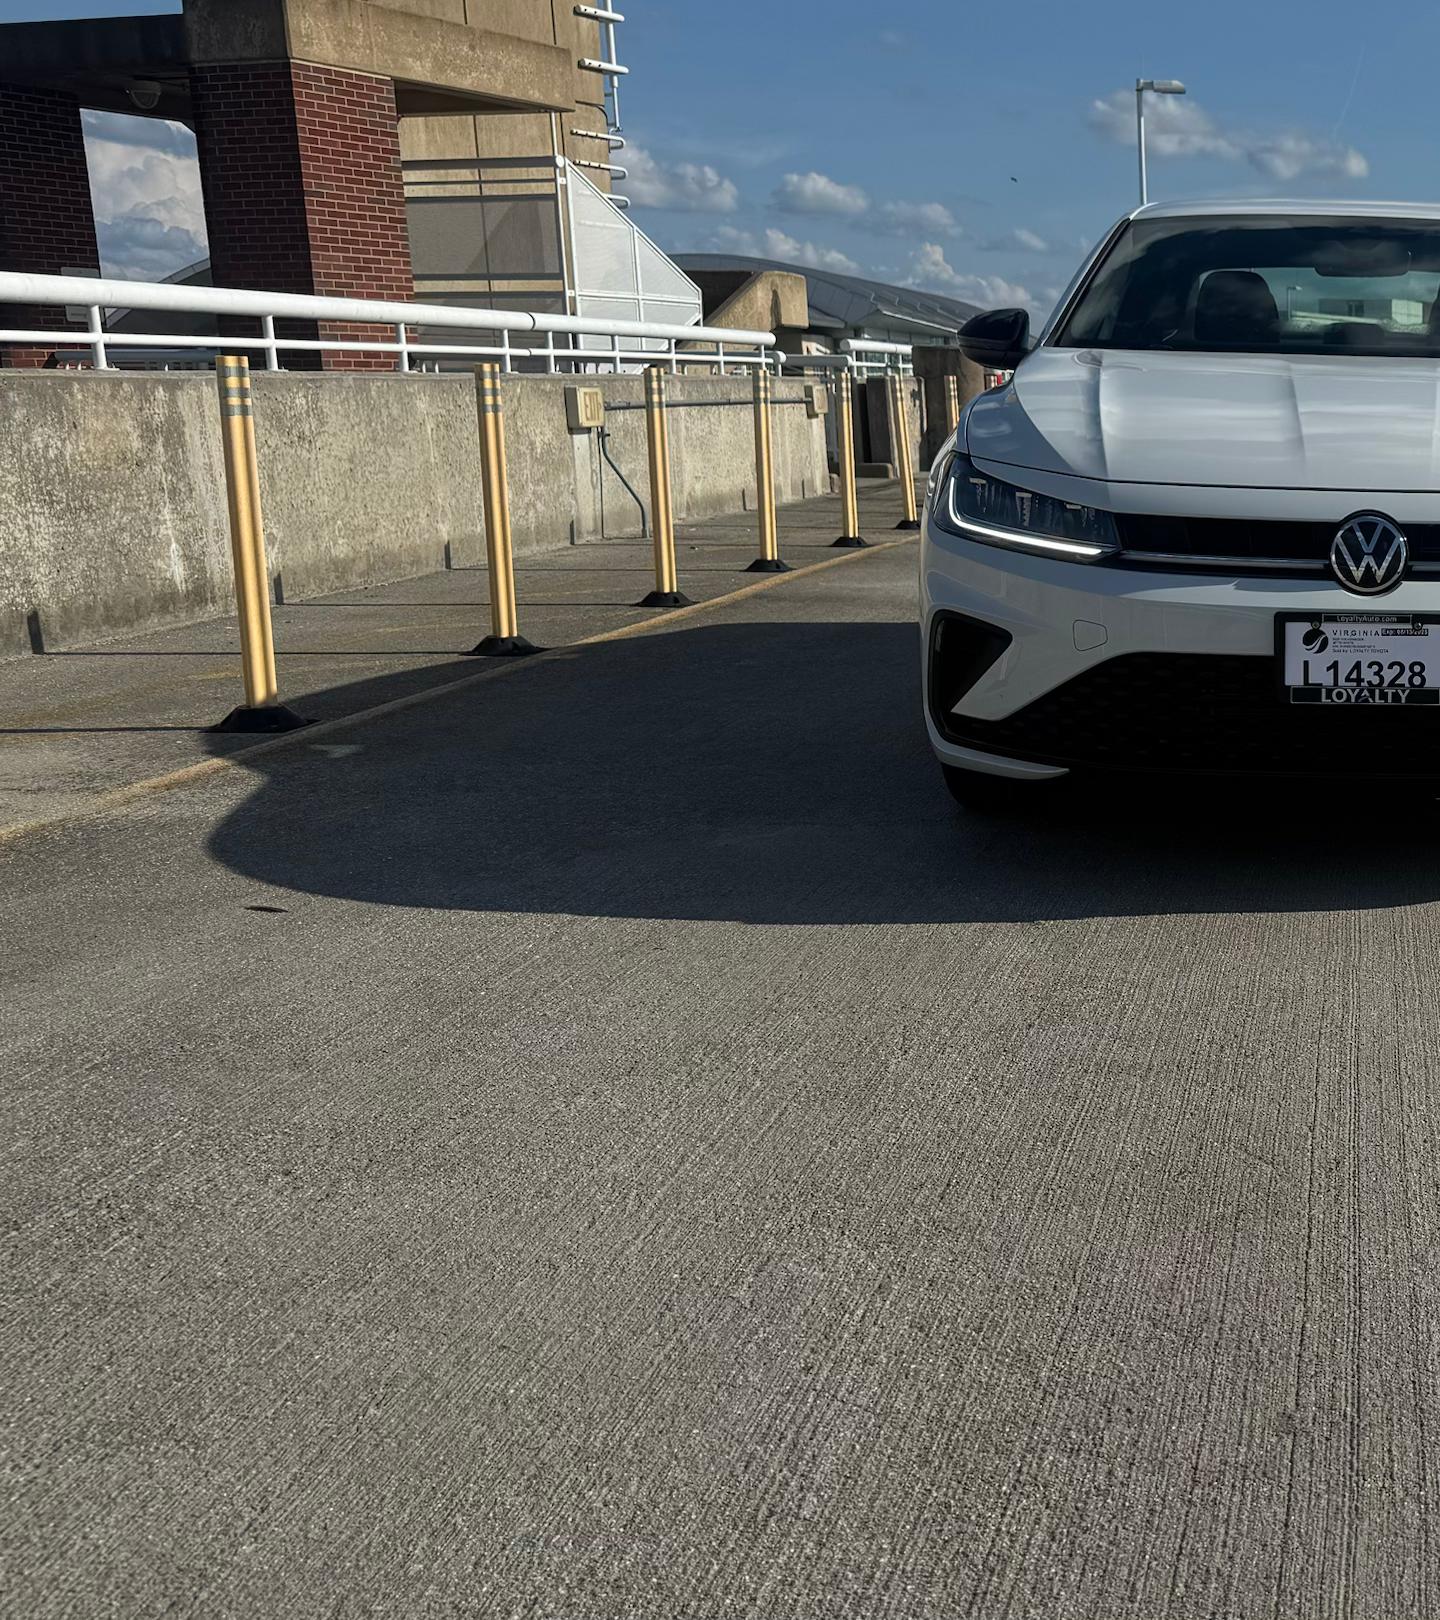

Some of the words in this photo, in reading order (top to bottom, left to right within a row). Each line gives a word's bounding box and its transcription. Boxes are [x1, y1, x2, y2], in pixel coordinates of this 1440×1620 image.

[1336, 615, 1397, 623] LoyaltyAuto.com
[1332, 629, 1380, 637] VIRGINIA
[1303, 660, 1427, 687] L14328
[1321, 688, 1410, 703] LOYALTY
